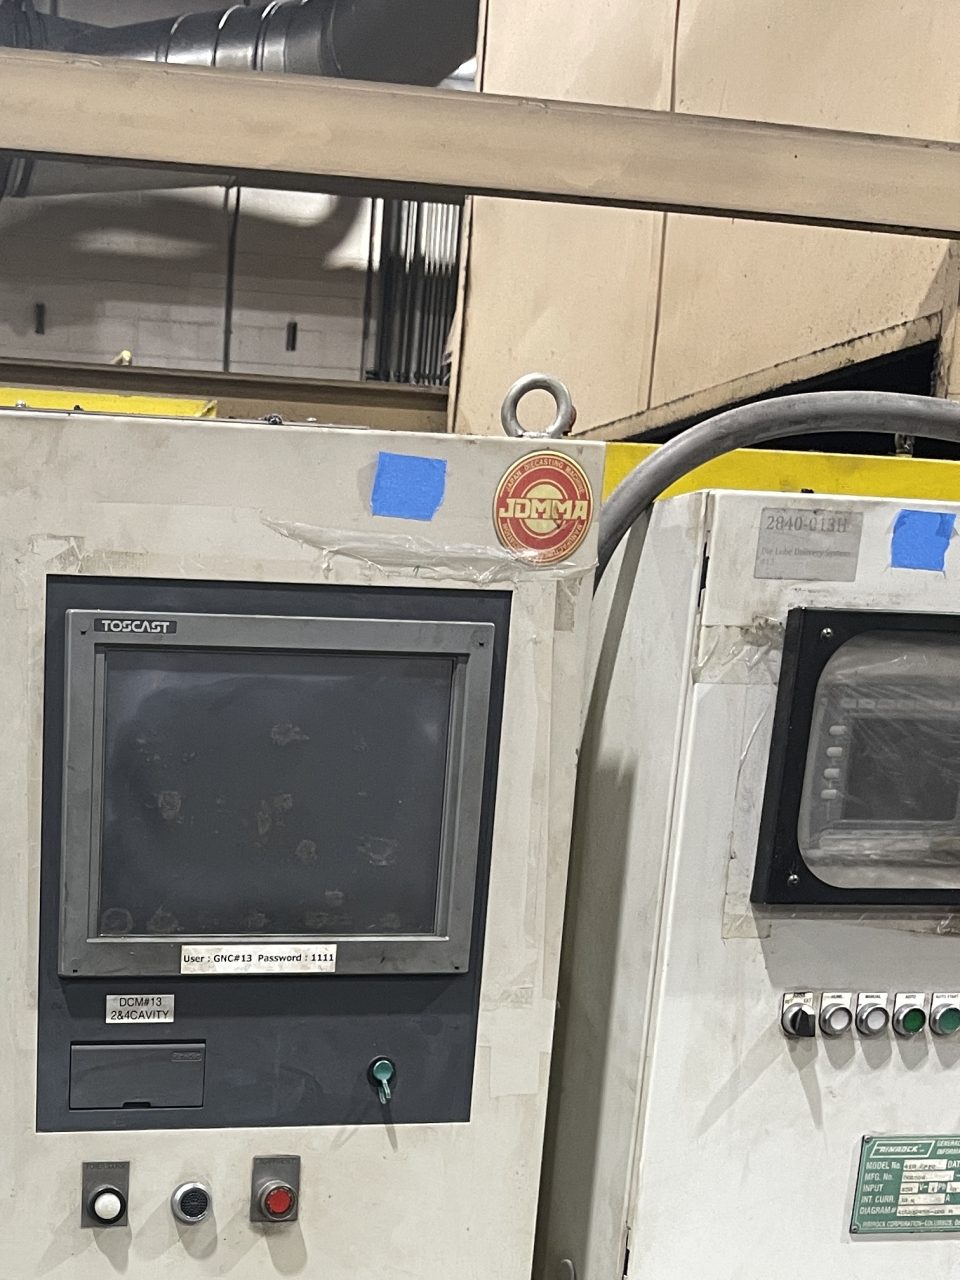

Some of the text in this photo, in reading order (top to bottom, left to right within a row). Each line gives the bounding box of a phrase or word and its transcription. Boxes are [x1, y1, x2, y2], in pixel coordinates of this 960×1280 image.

[506, 469, 522, 492] JAPAN
[524, 458, 563, 471] DIECASTING
[499, 498, 588, 520] JDMMA
[101, 620, 170, 633] TOSCAST
[183, 953, 334, 963] User GNC#13 Password 1111
[119, 997, 162, 1007] DCM#13
[110, 1010, 169, 1020] 2&4CAVITY
[866, 1162, 889, 1170] MODEL
[863, 1184, 884, 1192] INPUT
